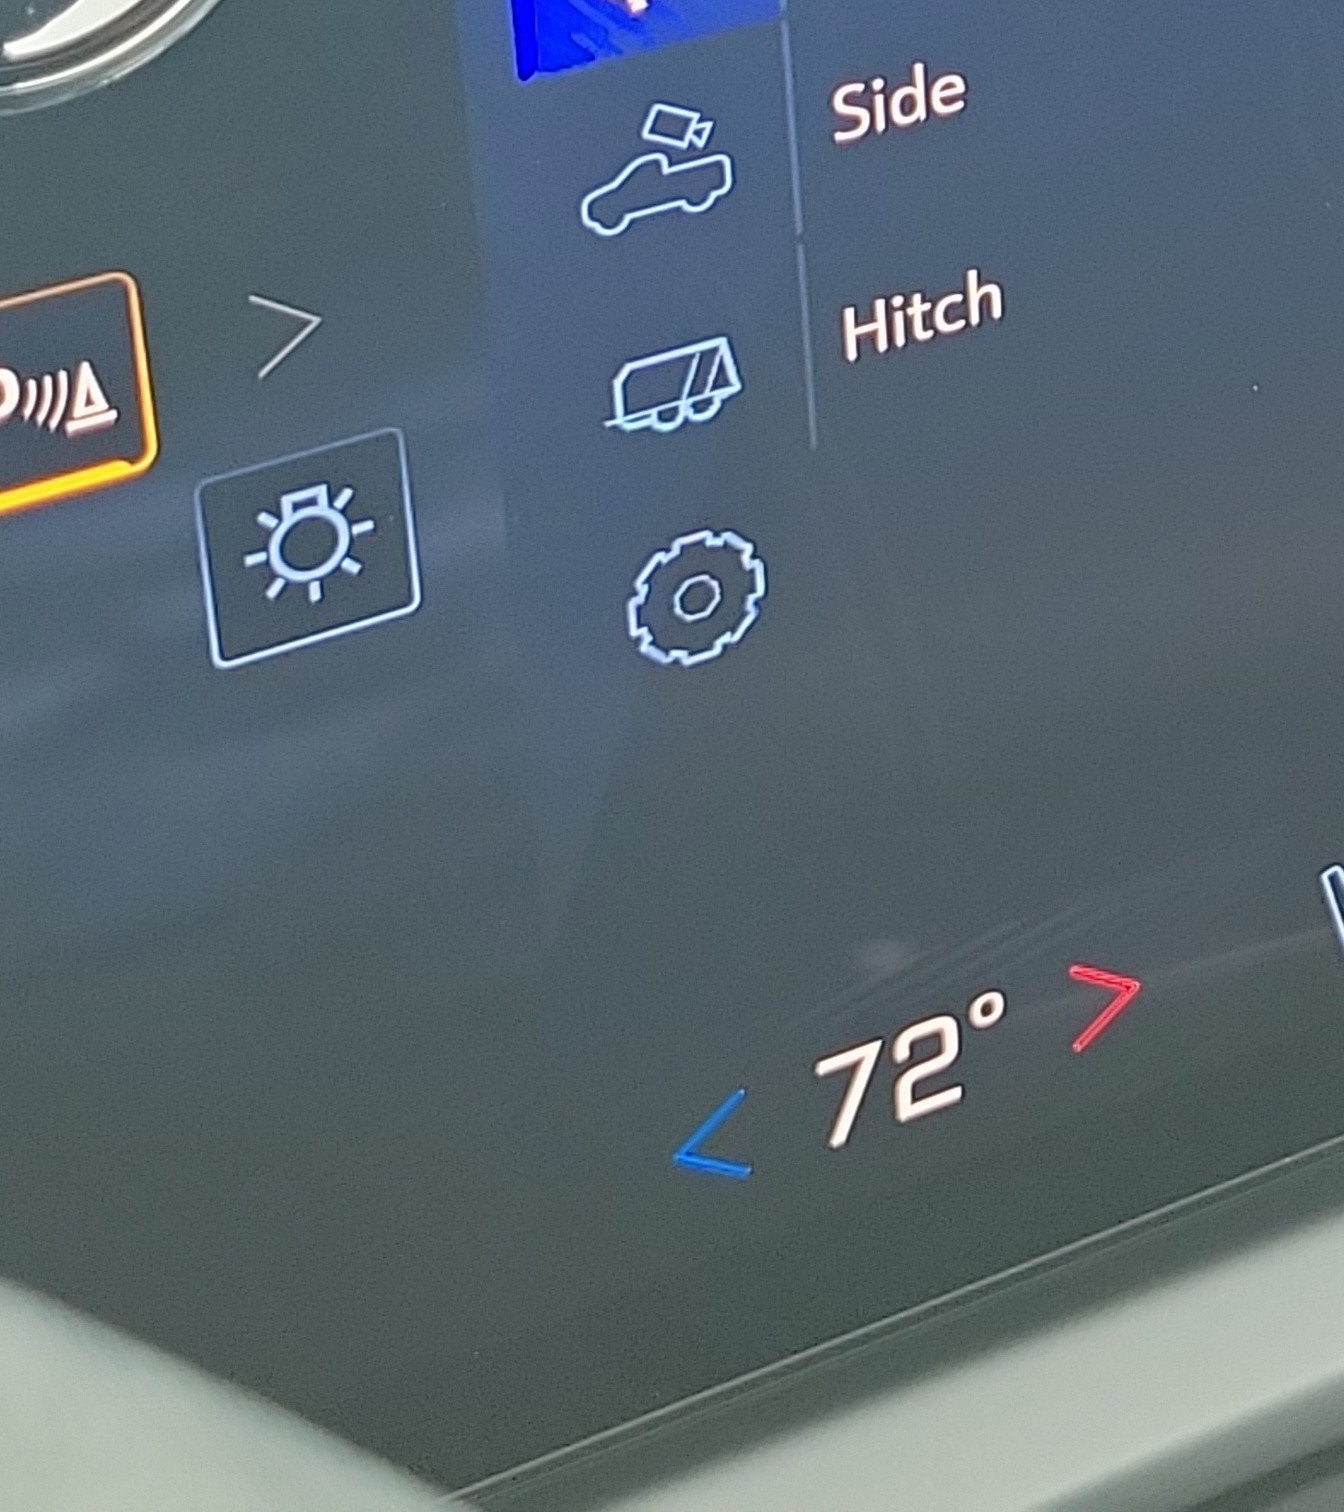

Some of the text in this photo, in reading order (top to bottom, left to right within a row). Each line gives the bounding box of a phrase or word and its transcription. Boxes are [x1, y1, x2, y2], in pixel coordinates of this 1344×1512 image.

[832, 62, 967, 144] Side
[841, 269, 1003, 362] Hitch
[814, 990, 1006, 1148] 72°
